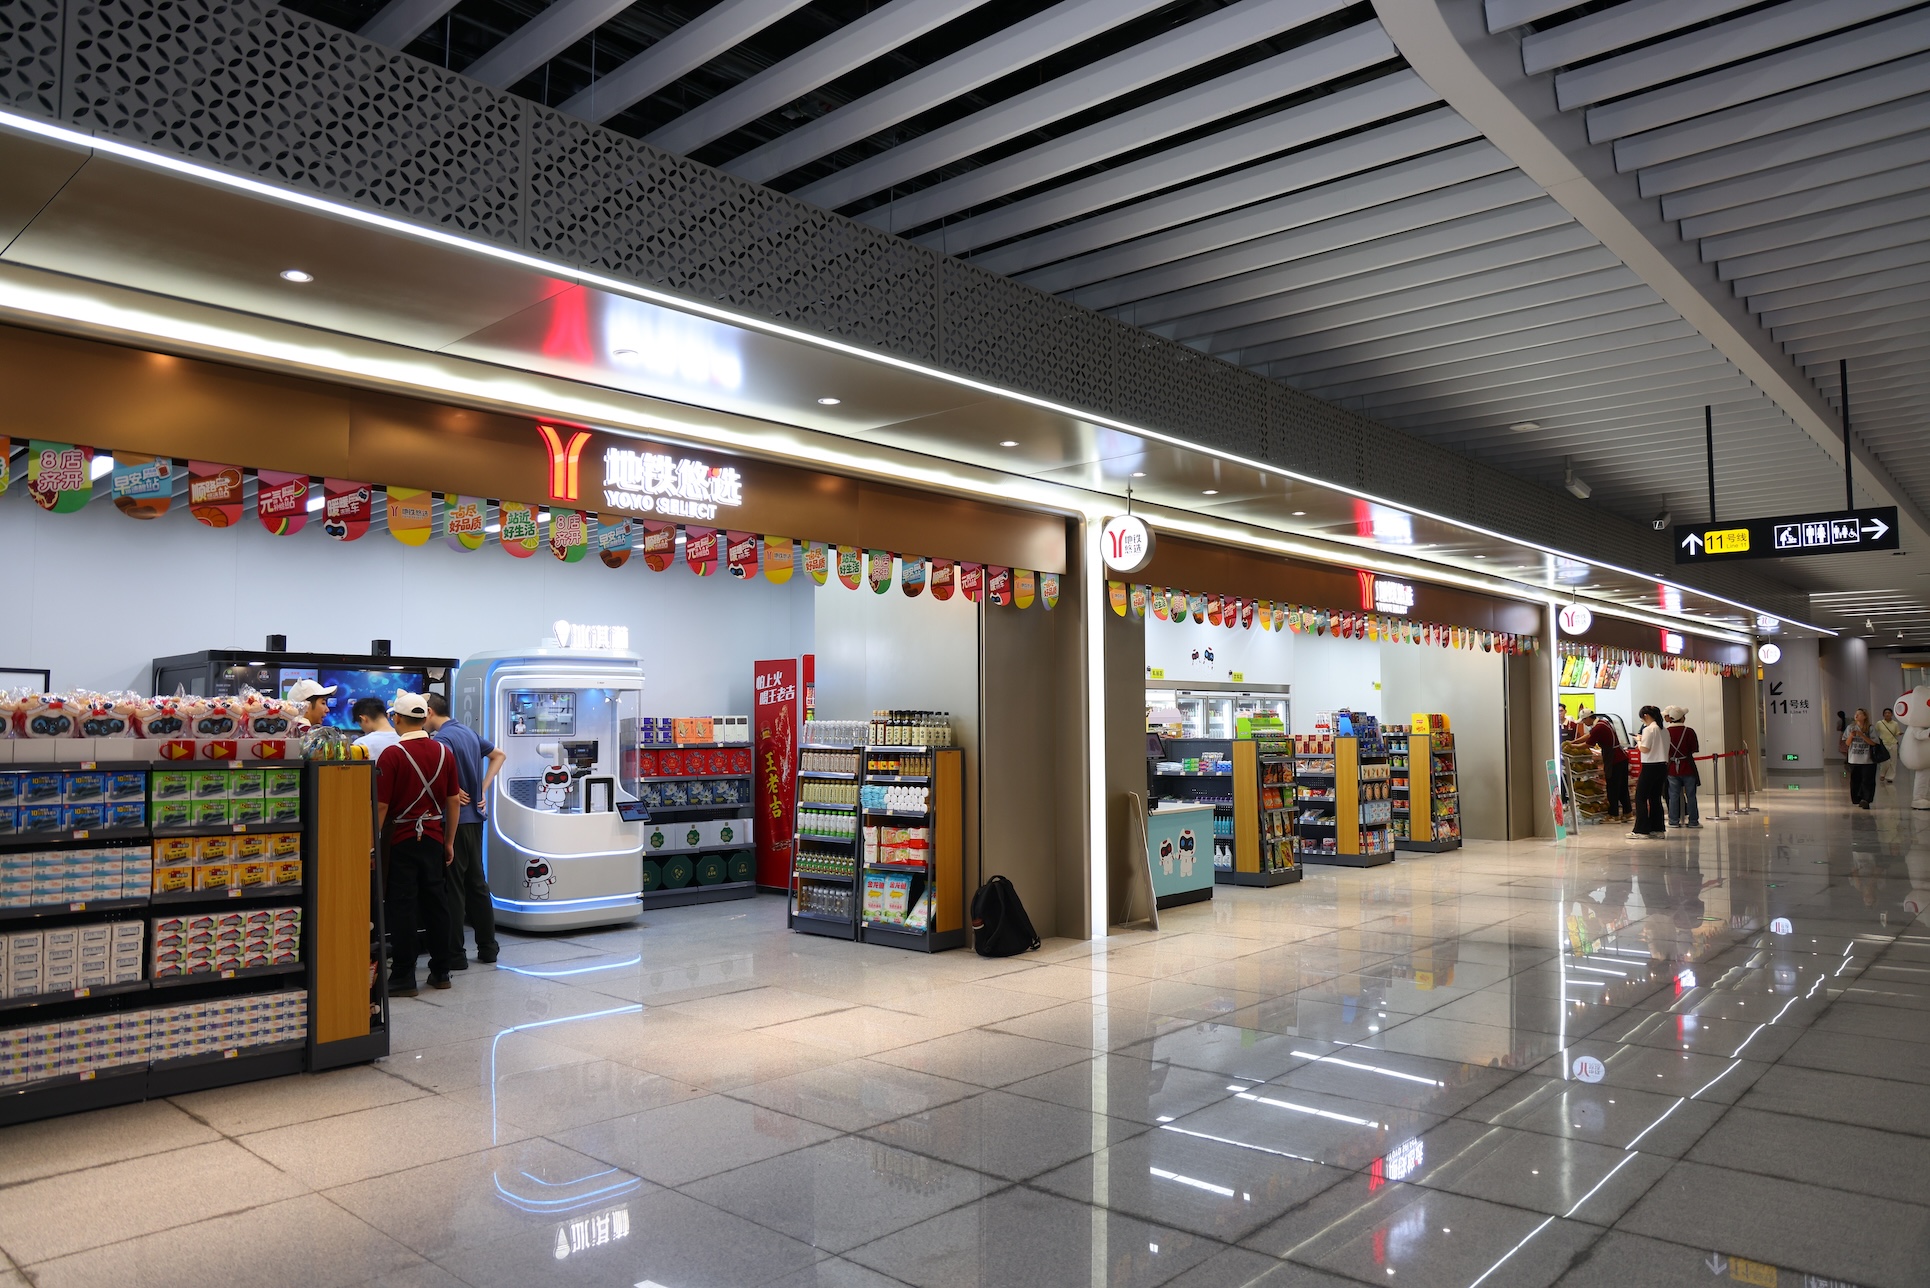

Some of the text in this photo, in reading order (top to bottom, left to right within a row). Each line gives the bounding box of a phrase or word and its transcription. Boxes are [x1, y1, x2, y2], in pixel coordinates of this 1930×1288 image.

[41, 450, 83, 470] 8店
[38, 471, 83, 491] 齐开
[604, 448, 742, 505] 地铁悠选
[604, 490, 718, 520] YOYO SELECT
[449, 515, 483, 533] 好品质
[508, 511, 531, 524] 站近
[556, 514, 581, 530] 8店
[503, 523, 537, 538] 好生活
[555, 530, 581, 547] 齐开
[756, 671, 782, 690] 怕上火
[759, 685, 796, 705] 喝王老吉
[765, 752, 783, 819] 王老吉
